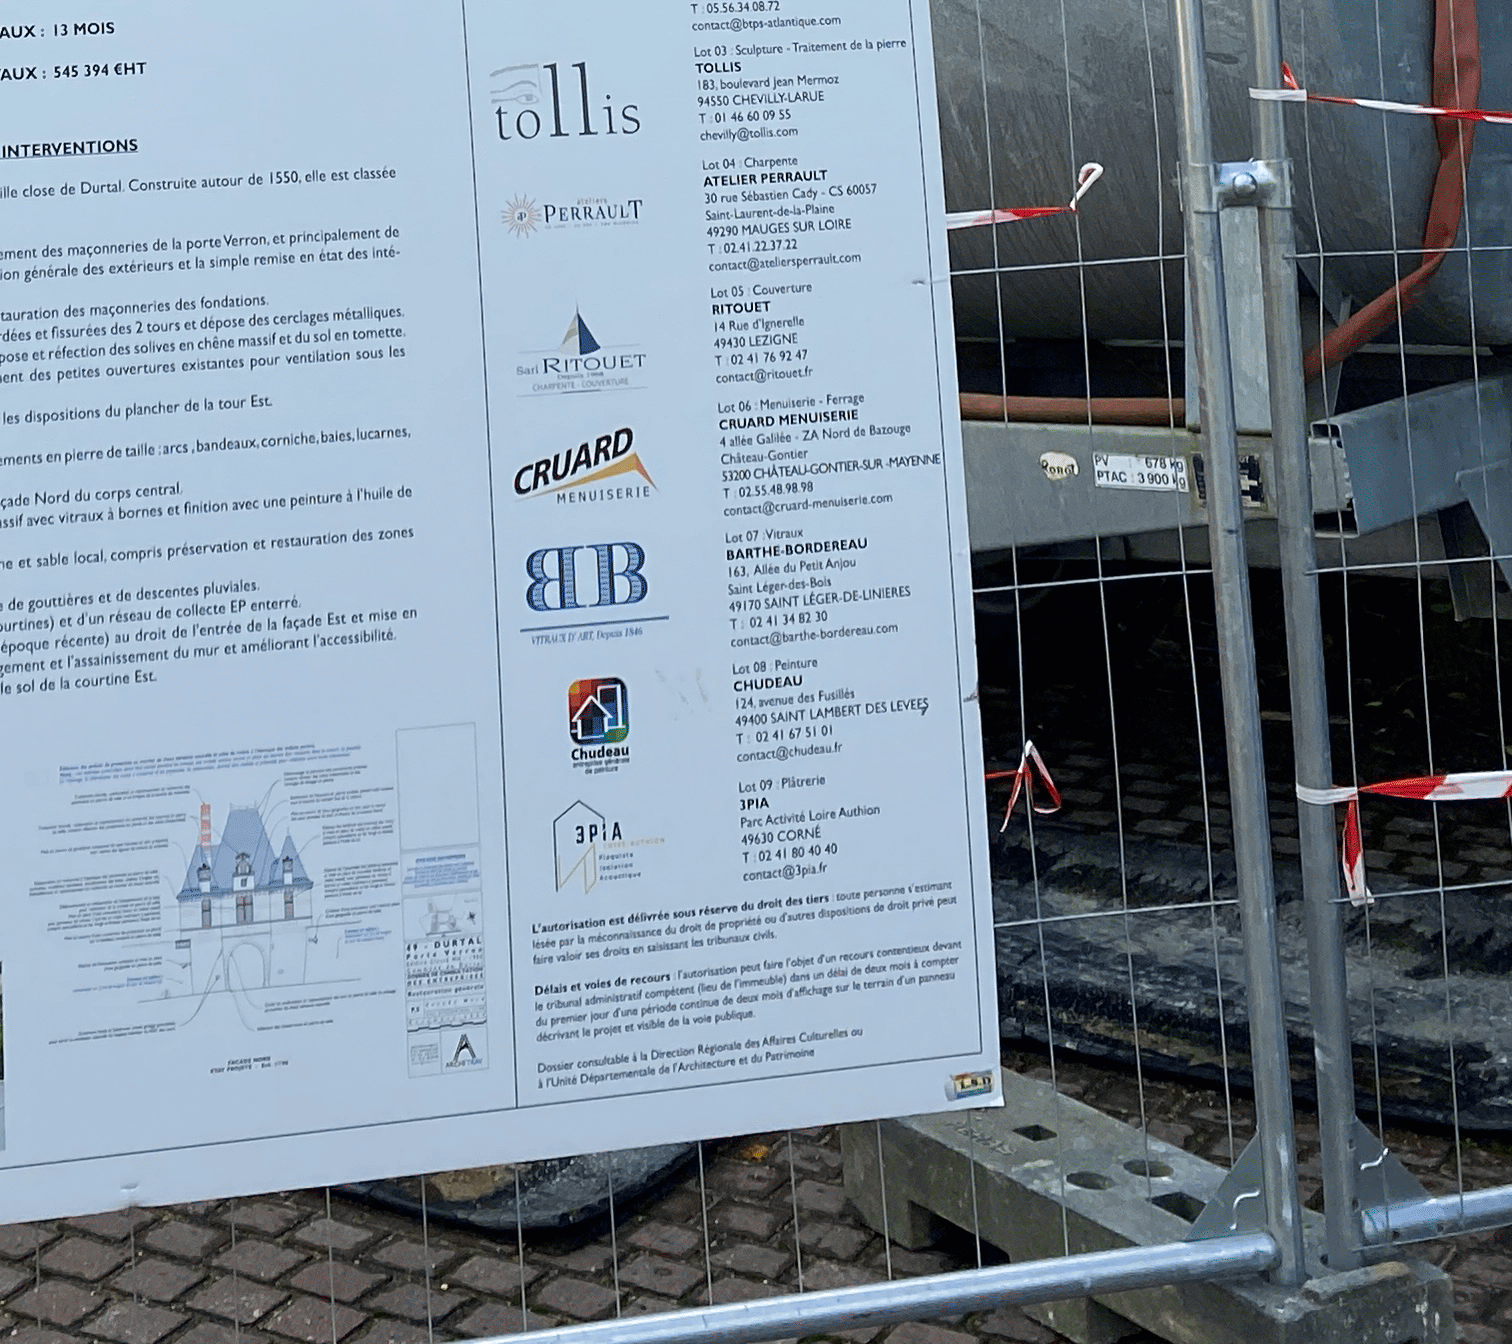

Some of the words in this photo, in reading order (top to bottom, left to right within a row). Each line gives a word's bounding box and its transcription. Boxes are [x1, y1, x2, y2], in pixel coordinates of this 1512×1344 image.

[53, 23, 69, 37] 13
[73, 21, 115, 36] MOIS
[53, 64, 79, 79] 545
[83, 63, 109, 78] 394
[113, 61, 148, 76] €HT
[694, 61, 742, 74] TOLLIS
[495, 61, 641, 140] tollis
[0, 138, 139, 160] INTERVENTIONS
[703, 173, 758, 188] ATELIER
[760, 169, 828, 185] PERRAULT
[543, 199, 643, 224] PERRAULT
[711, 300, 771, 316] RITOUET
[542, 353, 647, 374] RITOUET
[718, 415, 775, 431] CRUARD
[778, 408, 859, 426] MENUISERIE
[514, 427, 633, 496] CRUARD
[1094, 454, 1108, 466] PV
[1145, 457, 1167, 469] 678
[1169, 458, 1184, 473] kg
[1097, 470, 1128, 483] PTAC
[556, 483, 650, 505] MENUISERIE
[726, 538, 868, 561] BARTHE-BORDEREAU
[733, 675, 803, 693] CHUDEAU
[570, 745, 630, 761] Chudeau
[739, 796, 770, 811] 3PIA
[531, 917, 606, 935] L'autorisation
[608, 916, 625, 926] est
[627, 910, 670, 924] délivrée
[672, 909, 697, 920] sous
[698, 905, 738, 917] réserve
[740, 900, 755, 912] du
[756, 897, 783, 910] droit
[785, 896, 804, 907] des
[805, 894, 830, 905] tiers
